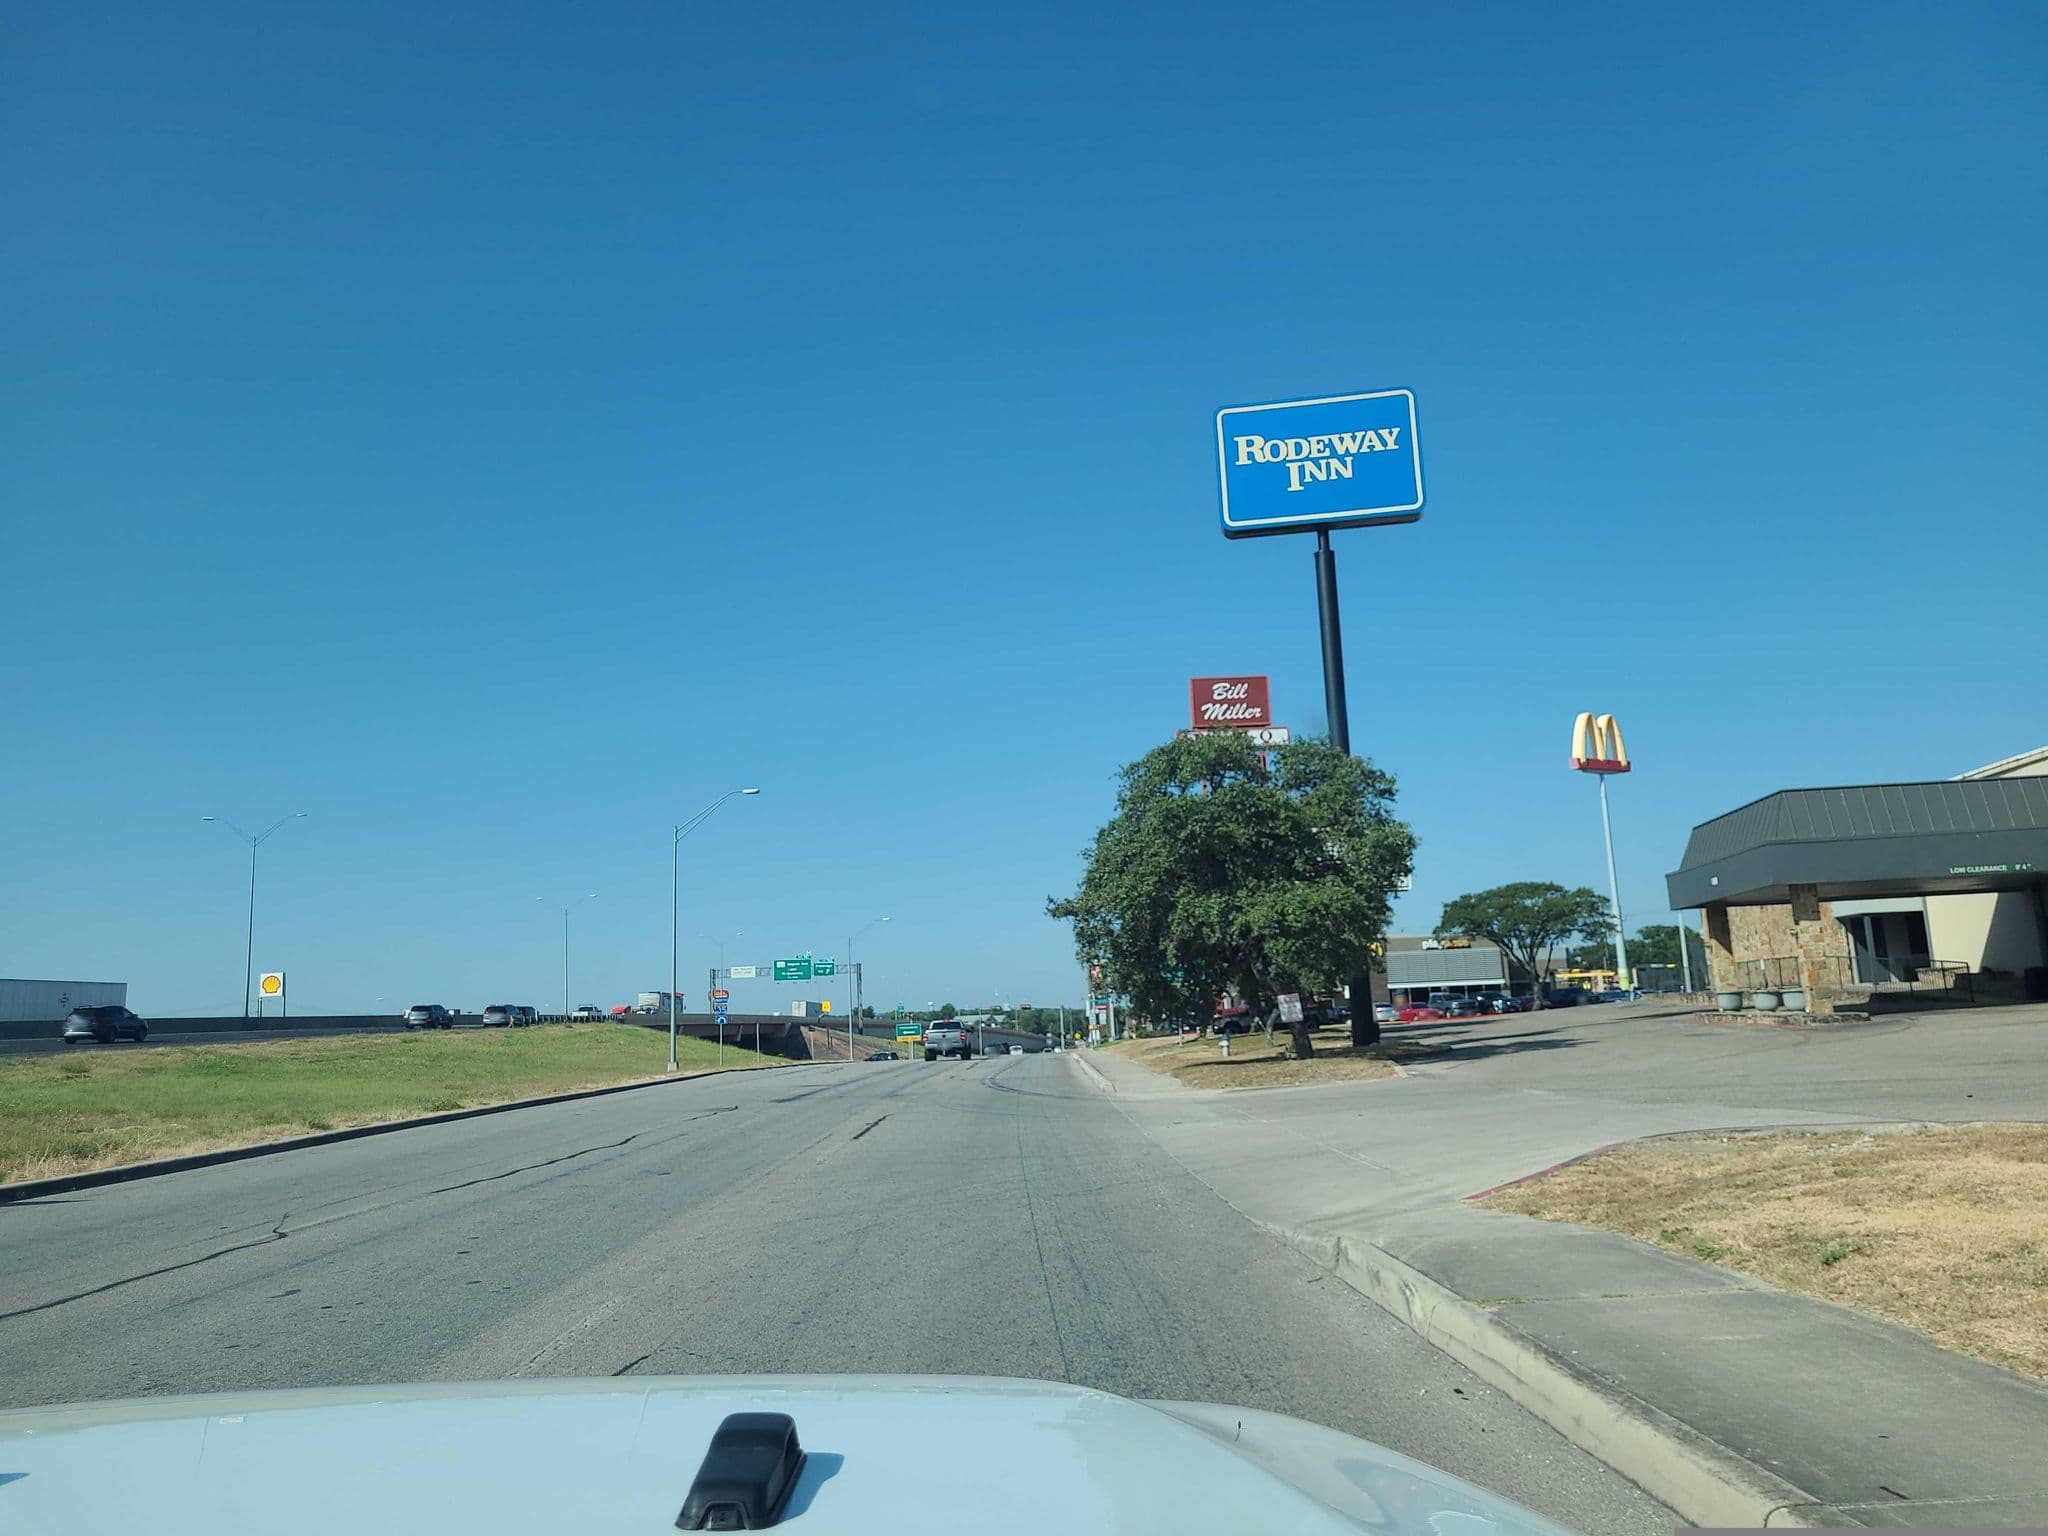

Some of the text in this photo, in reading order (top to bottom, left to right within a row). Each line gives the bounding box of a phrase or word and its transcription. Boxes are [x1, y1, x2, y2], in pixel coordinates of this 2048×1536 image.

[1233, 427, 1401, 466] RODEWAY
[1285, 456, 1354, 492] INN
[1211, 682, 1249, 701] Bill
[1200, 702, 1263, 721] Miller
[1966, 864, 2007, 873] CLEARANCE
